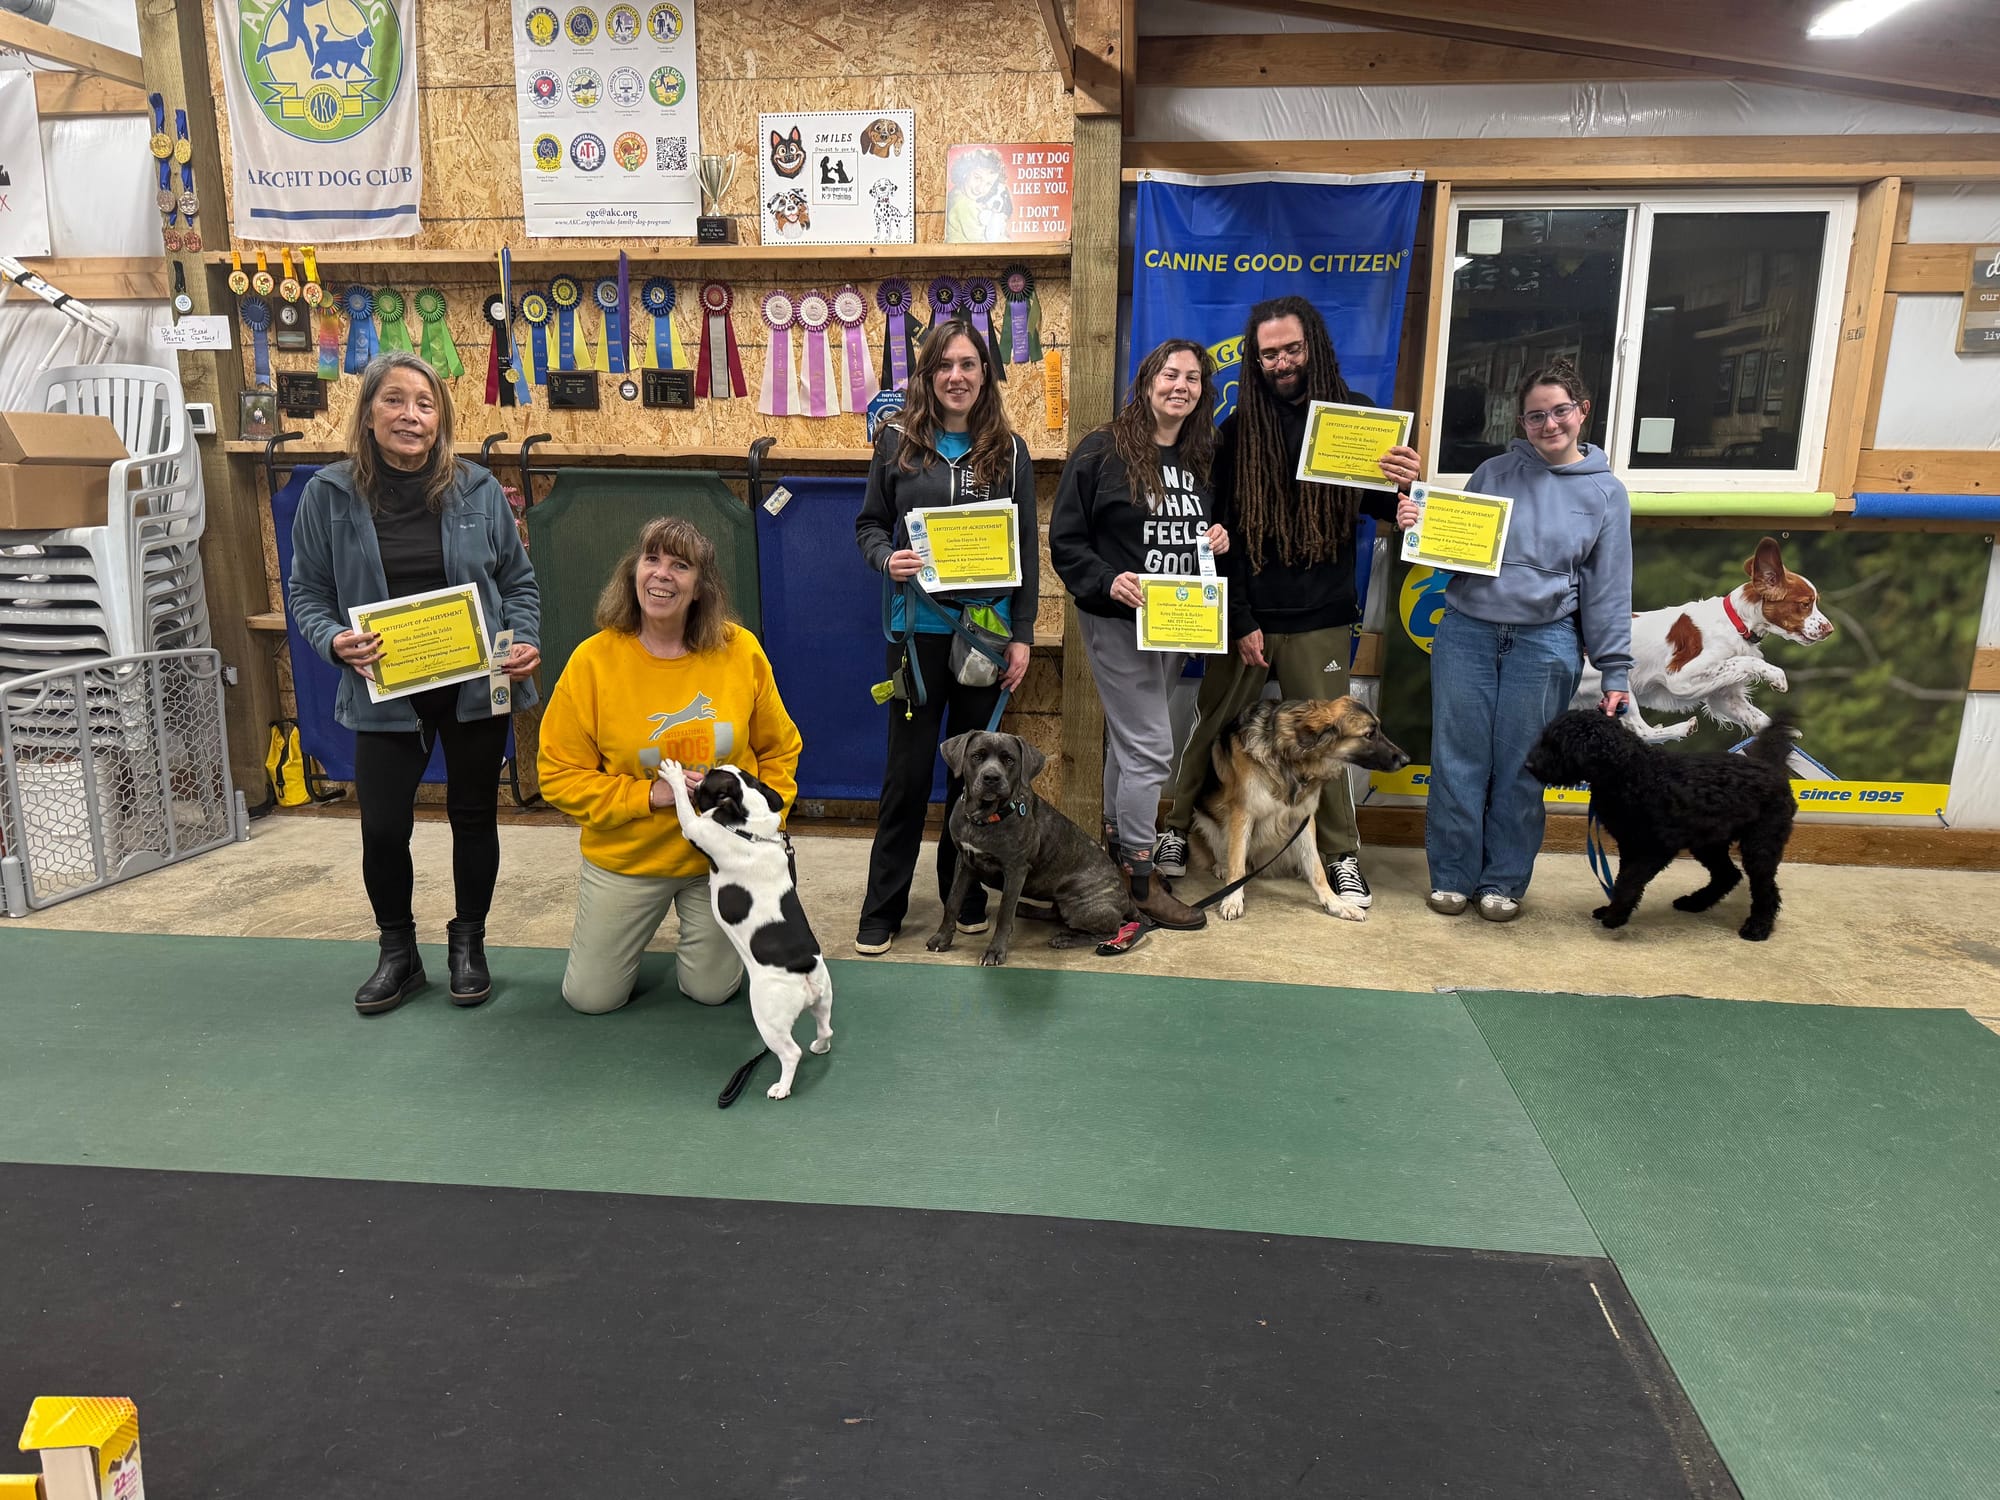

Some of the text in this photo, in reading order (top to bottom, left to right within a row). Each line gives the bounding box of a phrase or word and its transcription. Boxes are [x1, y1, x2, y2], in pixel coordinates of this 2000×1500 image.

[311, 93, 337, 122] AKC
[815, 133, 852, 143] SMILES
[580, 142, 596, 159] ATT
[1012, 152, 1070, 165] IF MY DOG
[249, 166, 413, 188] AKC FIT DOG CLUB
[1017, 167, 1064, 179] DOESN'T
[1013, 182, 1069, 195] LIKE YOU,
[586, 208, 638, 219] cgc@akc.org
[1019, 206, 1059, 218] I DON'T
[1012, 221, 1068, 233] LIKE YOU.
[1144, 249, 1228, 272] CANINE
[1234, 254, 1303, 273] GOOD
[1980, 293, 2000, 301] our
[1326, 421, 1353, 429] CERTIFICATE
[1359, 425, 1394, 433] ACHIEVEMENT
[1460, 509, 1494, 519] ACHIEVEMENT
[1144, 548, 1197, 576] GOO
[379, 620, 413, 633] CERTIFICATE
[422, 608, 463, 623] ACHIEVEMENT
[385, 657, 414, 669] Whispering
[427, 649, 448, 659] Training
[449, 645, 470, 653] Academy
[664, 728, 707, 738] INTERNATIONAL
[666, 736, 710, 762] DOG
[1798, 788, 1904, 803] since 1995
[113, 1472, 126, 1496] 22
